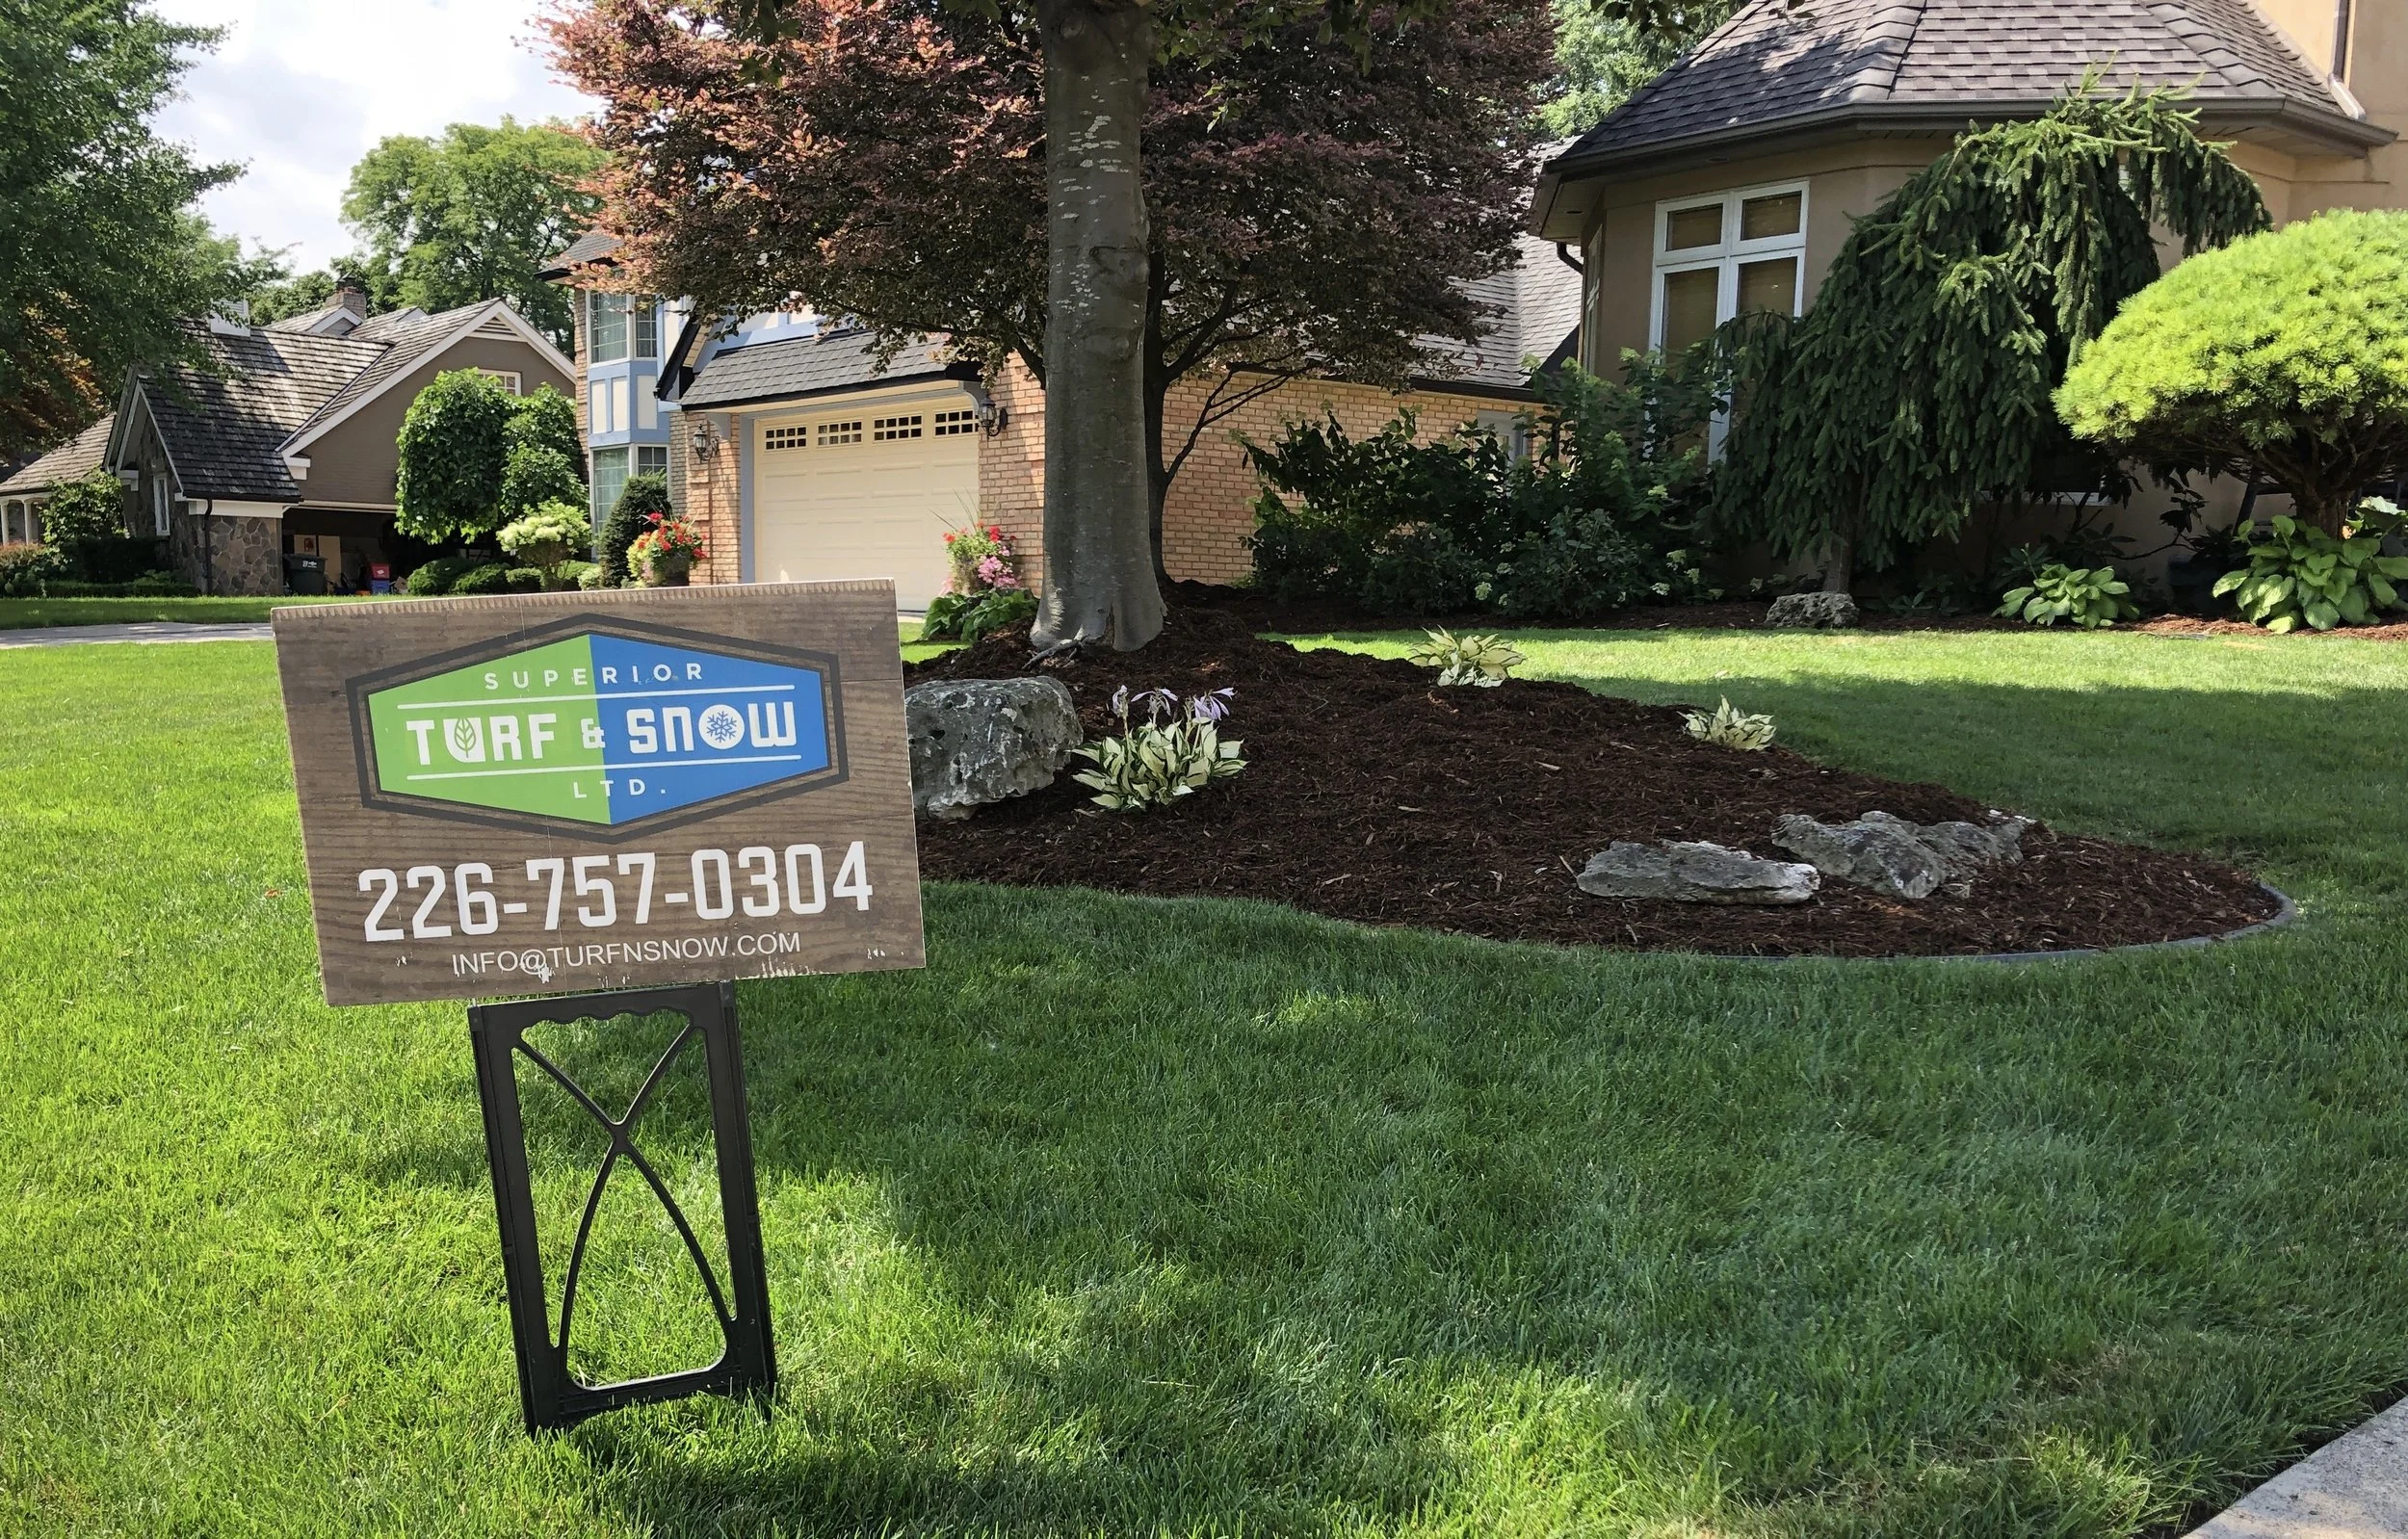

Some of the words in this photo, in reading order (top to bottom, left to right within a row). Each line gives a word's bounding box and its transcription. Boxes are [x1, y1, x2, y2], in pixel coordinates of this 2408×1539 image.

[484, 663, 703, 691] SUPERIOR
[406, 713, 557, 766] TURF
[581, 718, 606, 748] &
[626, 701, 797, 754] SNOW
[573, 778, 667, 799] LTD.
[358, 841, 873, 942] 226-757-0304
[452, 932, 800, 976] INFO@TURFNSNOW.COM
